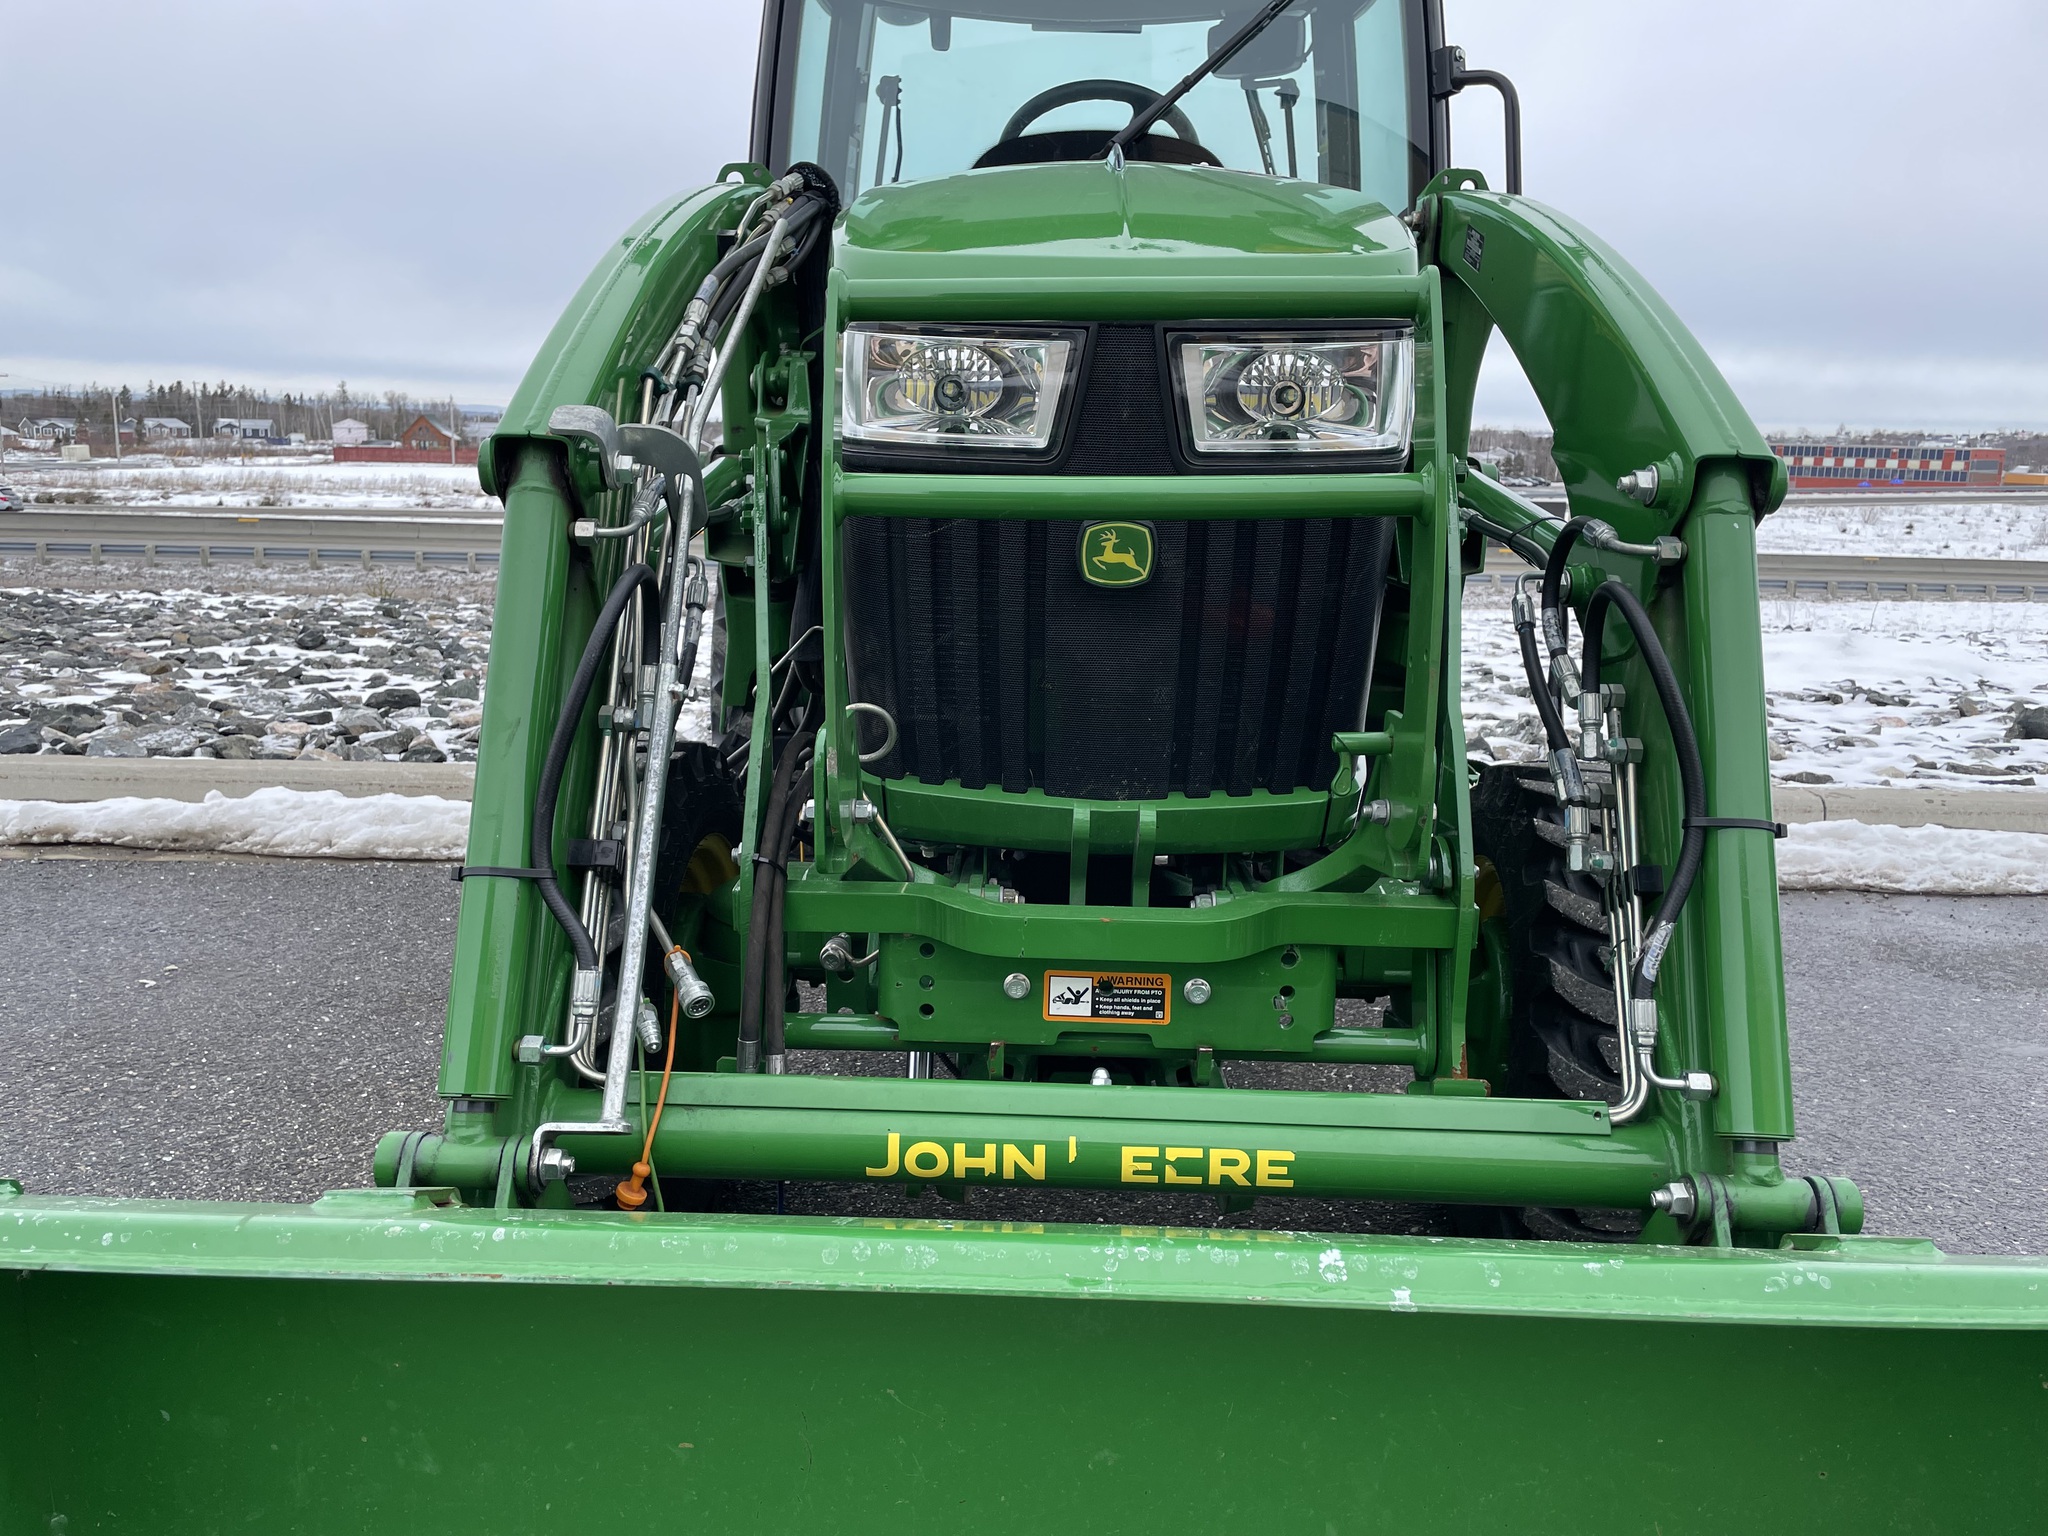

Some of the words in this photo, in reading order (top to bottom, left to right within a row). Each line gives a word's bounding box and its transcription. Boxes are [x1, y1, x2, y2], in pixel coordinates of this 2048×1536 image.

[1107, 976, 1163, 986] WARNING
[866, 1132, 1046, 1180] JOHN
[1068, 1135, 1296, 1188] EERE
